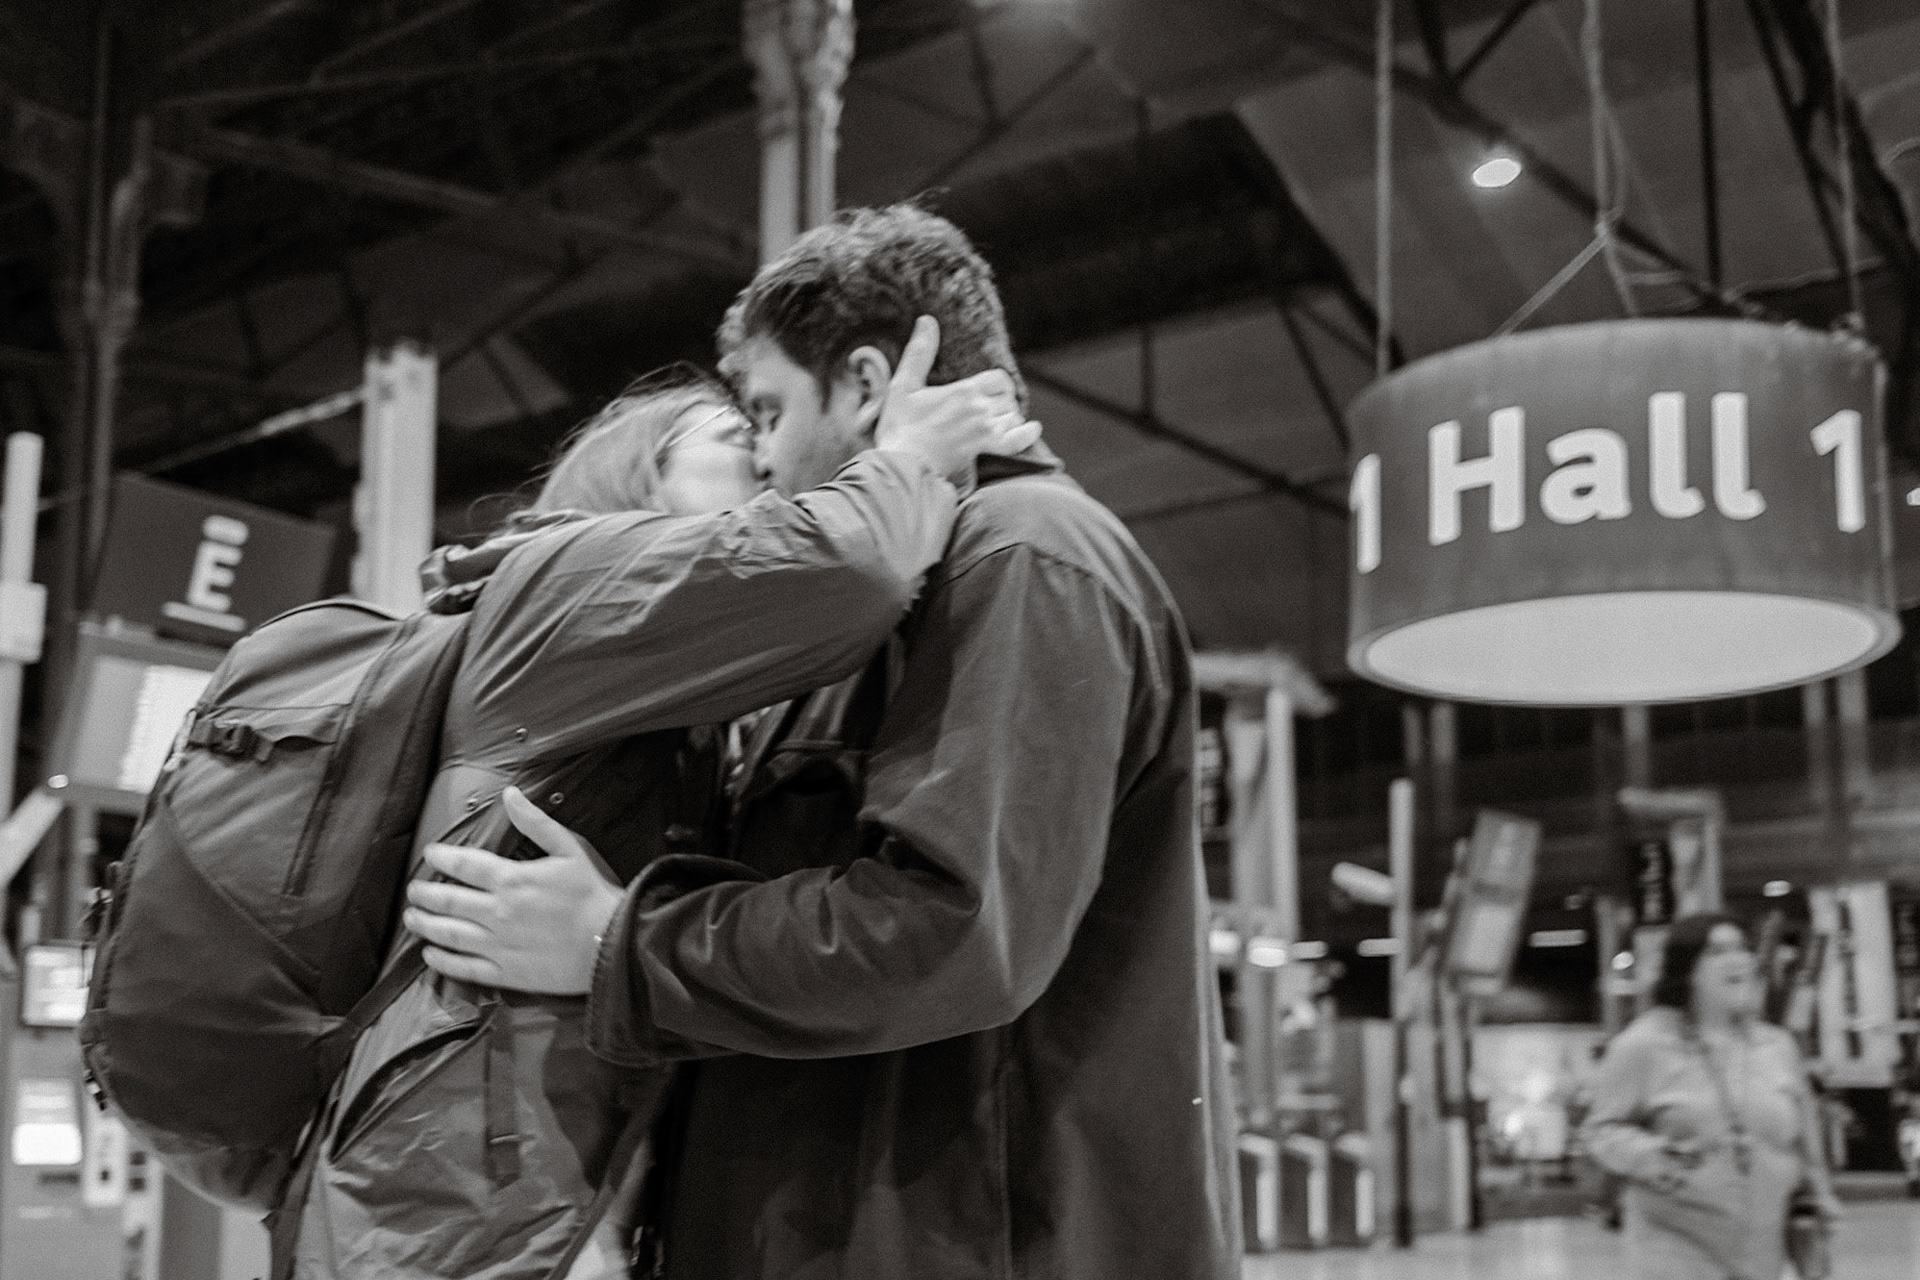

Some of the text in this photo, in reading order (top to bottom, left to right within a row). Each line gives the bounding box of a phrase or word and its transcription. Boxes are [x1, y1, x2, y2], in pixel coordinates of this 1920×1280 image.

[1349, 452, 1382, 575] 1
[1427, 389, 1867, 546] Hall 1
